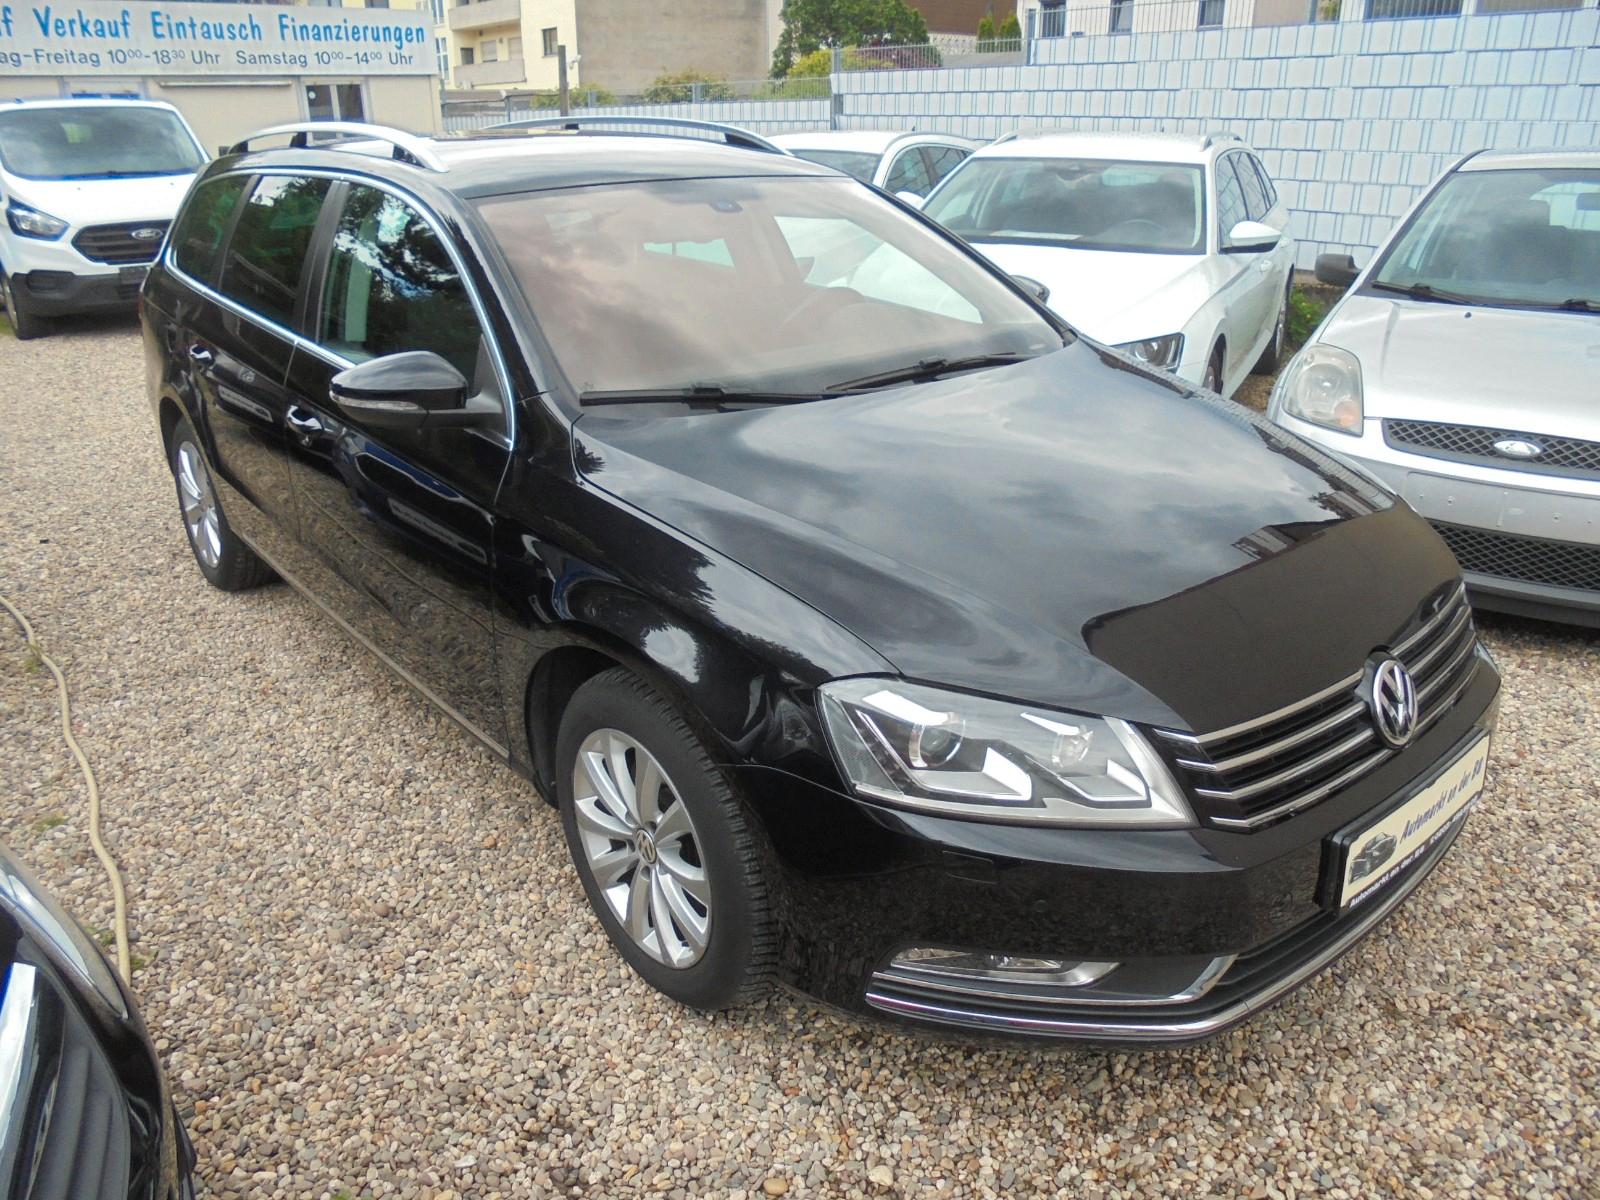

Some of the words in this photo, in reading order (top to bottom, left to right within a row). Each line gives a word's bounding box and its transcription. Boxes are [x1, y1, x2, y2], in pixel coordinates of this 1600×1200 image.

[32, 5, 132, 39] Verkauf
[150, 10, 262, 41] Eintausch
[277, 13, 426, 50] Finanzierungen
[191, 49, 220, 65] Uhr
[235, 49, 309, 67] Samstag
[388, 51, 414, 66] Uhr
[1399, 789, 1448, 845] Automarkt
[1349, 873, 1390, 909] Automarkt
